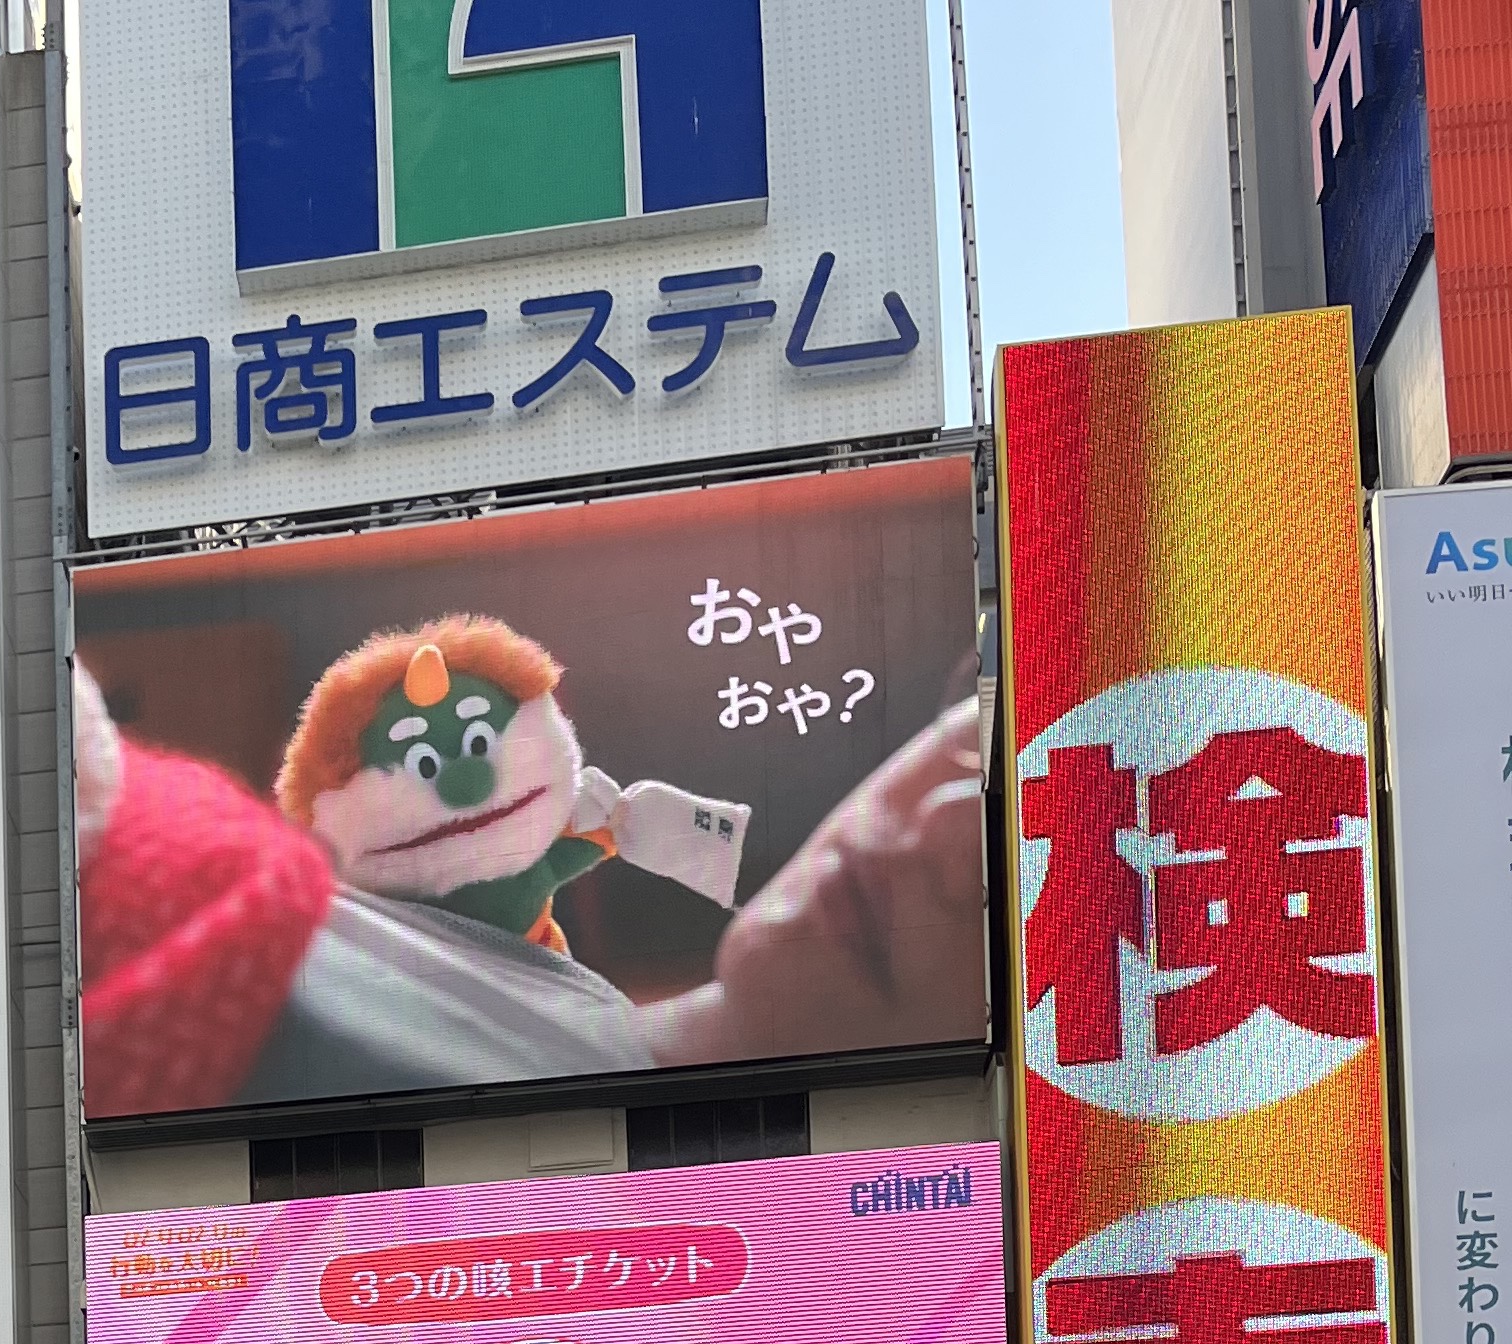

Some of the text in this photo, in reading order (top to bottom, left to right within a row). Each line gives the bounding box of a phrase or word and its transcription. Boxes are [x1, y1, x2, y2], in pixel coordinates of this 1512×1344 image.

[104, 251, 920, 465] 日商エステム
[687, 578, 822, 665] おや
[1426, 583, 1512, 604] いい明日
[717, 668, 876, 735] おや?
[851, 1164, 973, 1218] CHINTAI
[350, 1245, 715, 1309] 3つの咳エチケット
